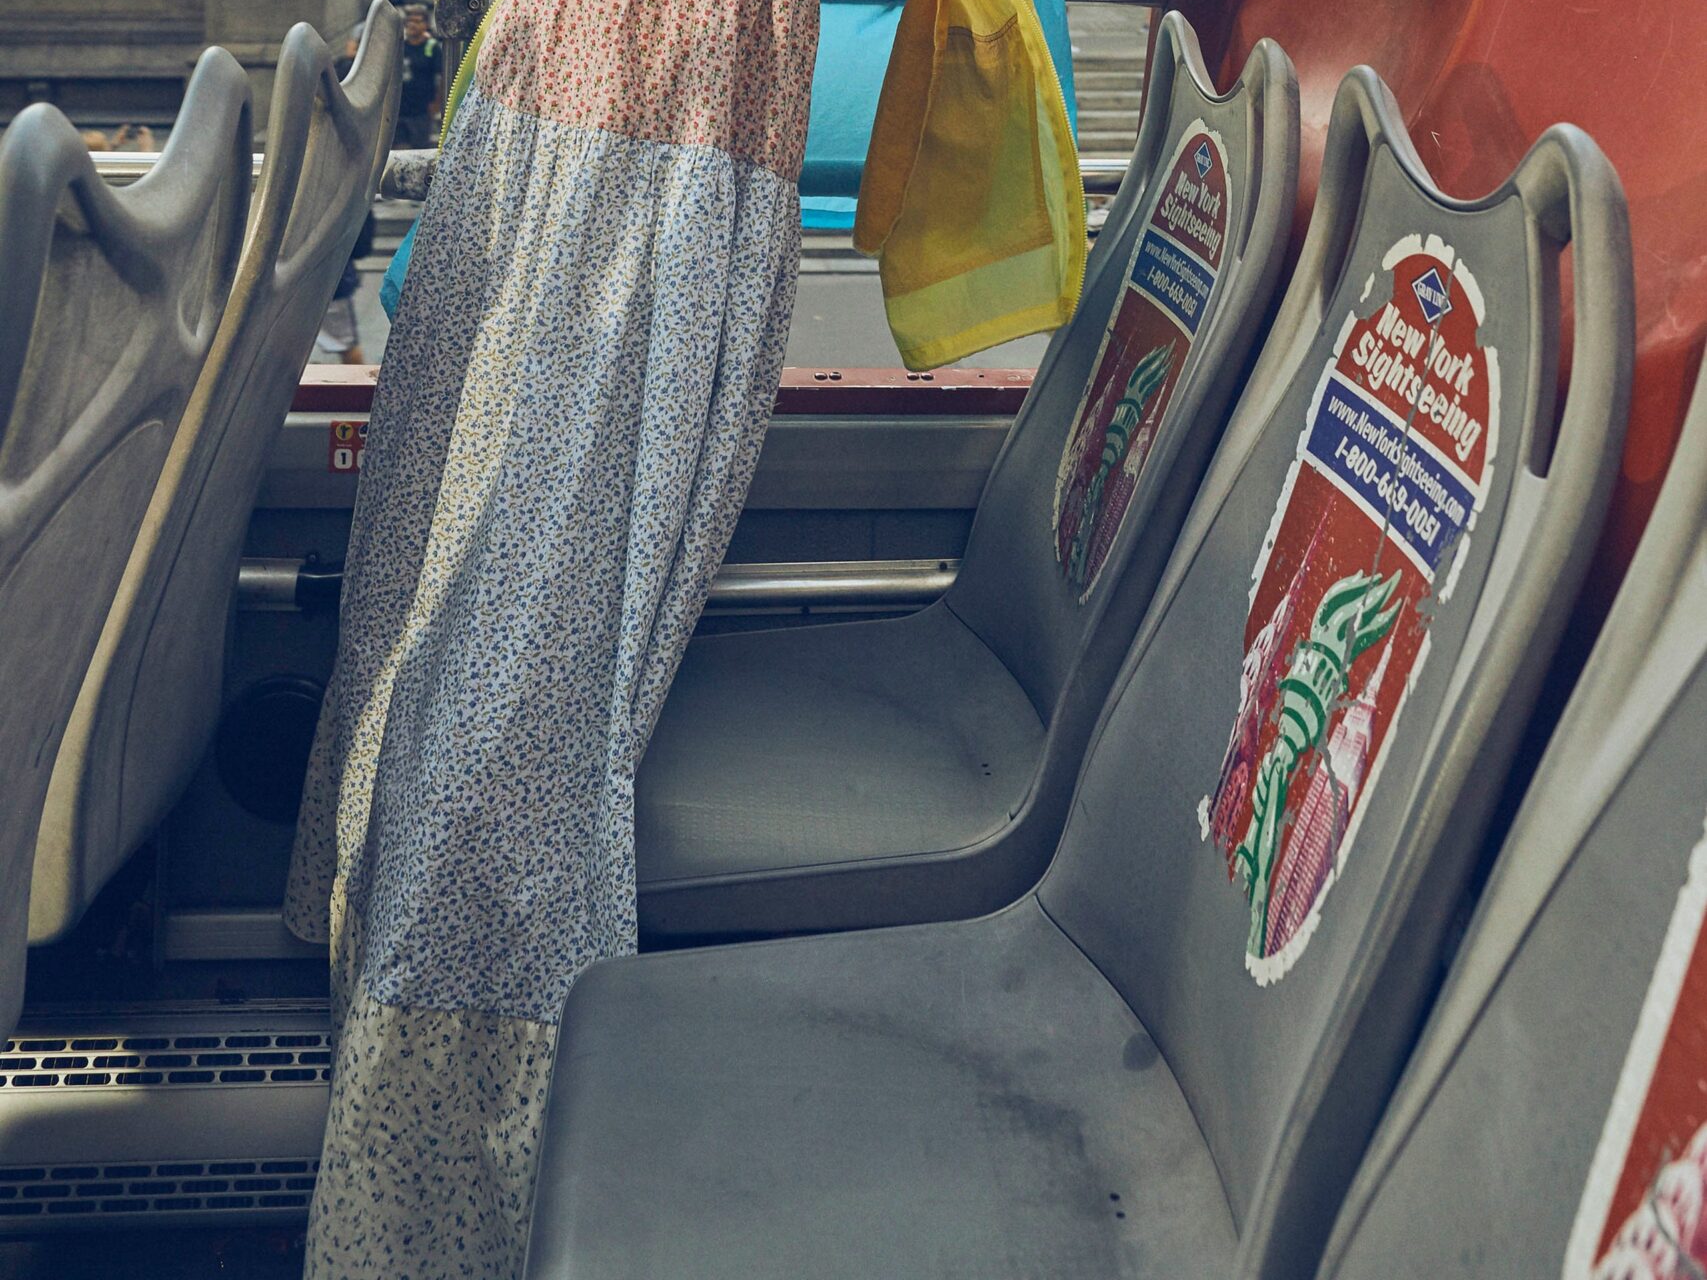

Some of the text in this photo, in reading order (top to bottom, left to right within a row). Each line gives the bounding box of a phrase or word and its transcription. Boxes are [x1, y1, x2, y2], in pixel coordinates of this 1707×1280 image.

[1161, 193, 1221, 260] Sightseeing
[1175, 170, 1221, 219] New York
[1147, 265, 1198, 318] 1-800-669-0051
[1417, 280, 1433, 302] GRAY
[1375, 302, 1475, 396] New York
[1352, 330, 1482, 462] Sightseeing
[1328, 396, 1465, 526] www.NewYorkSightseeing.com
[1334, 436, 1441, 547] 1-800-669-0051
